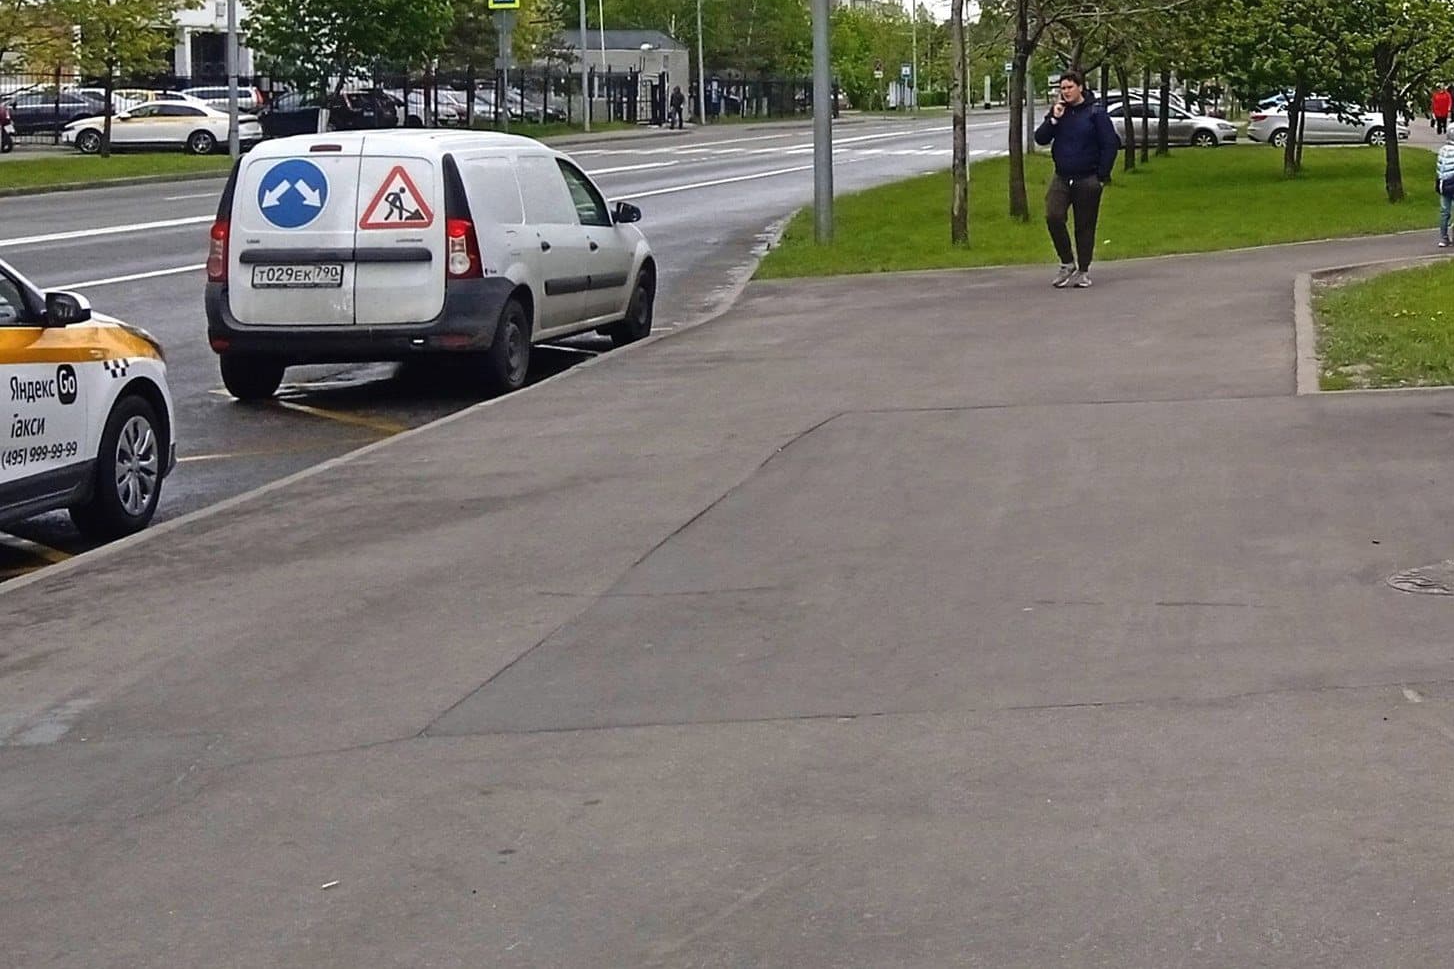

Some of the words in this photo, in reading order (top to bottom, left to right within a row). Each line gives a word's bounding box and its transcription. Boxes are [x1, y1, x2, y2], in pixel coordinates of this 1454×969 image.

[10, 376, 56, 404] Яндекс
[60, 369, 76, 394] Go
[1, 448, 28, 470] (495)
[29, 441, 78, 462] 999-99-99
